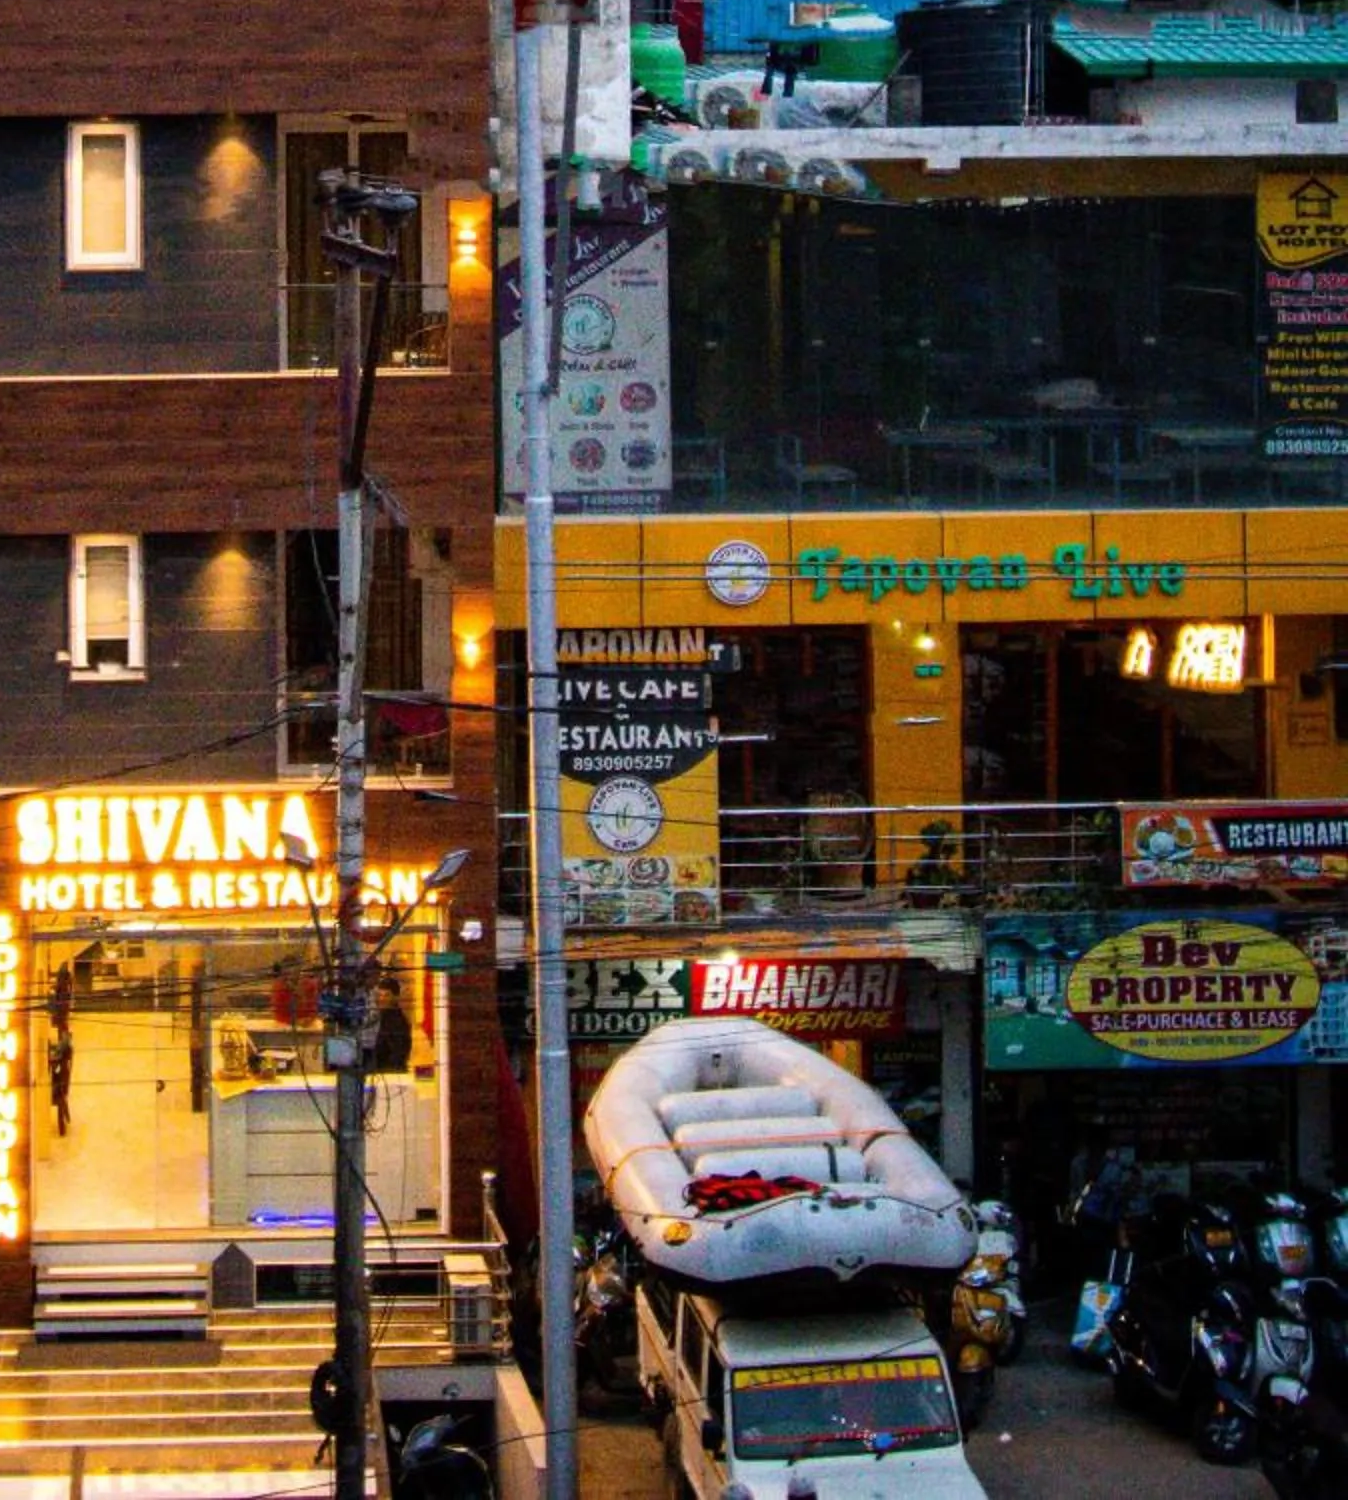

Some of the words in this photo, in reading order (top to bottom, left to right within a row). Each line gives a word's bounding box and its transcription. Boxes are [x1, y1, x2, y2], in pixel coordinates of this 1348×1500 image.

[1267, 224, 1311, 236] LOT
[797, 547, 1029, 603] Tapovan
[1054, 543, 1186, 600] Live
[556, 627, 706, 661] APOVAN
[617, 680, 700, 700] CAFE
[558, 724, 705, 751] ESTAURANT
[572, 755, 674, 772] 8930905257
[16, 794, 321, 864] SHIVANA
[21, 873, 144, 911] HOTEL
[151, 871, 180, 909] &
[189, 867, 440, 909] RESTAUAN
[1141, 933, 1243, 969] Dev
[564, 960, 685, 1010] BEX
[701, 962, 900, 1012] BHANDARI
[1089, 974, 1299, 1006] PROPERTY
[1091, 1011, 1226, 1032] SALE-PURCHACE
[1230, 1011, 1243, 1029] &
[1248, 1009, 1299, 1029] LEASE
